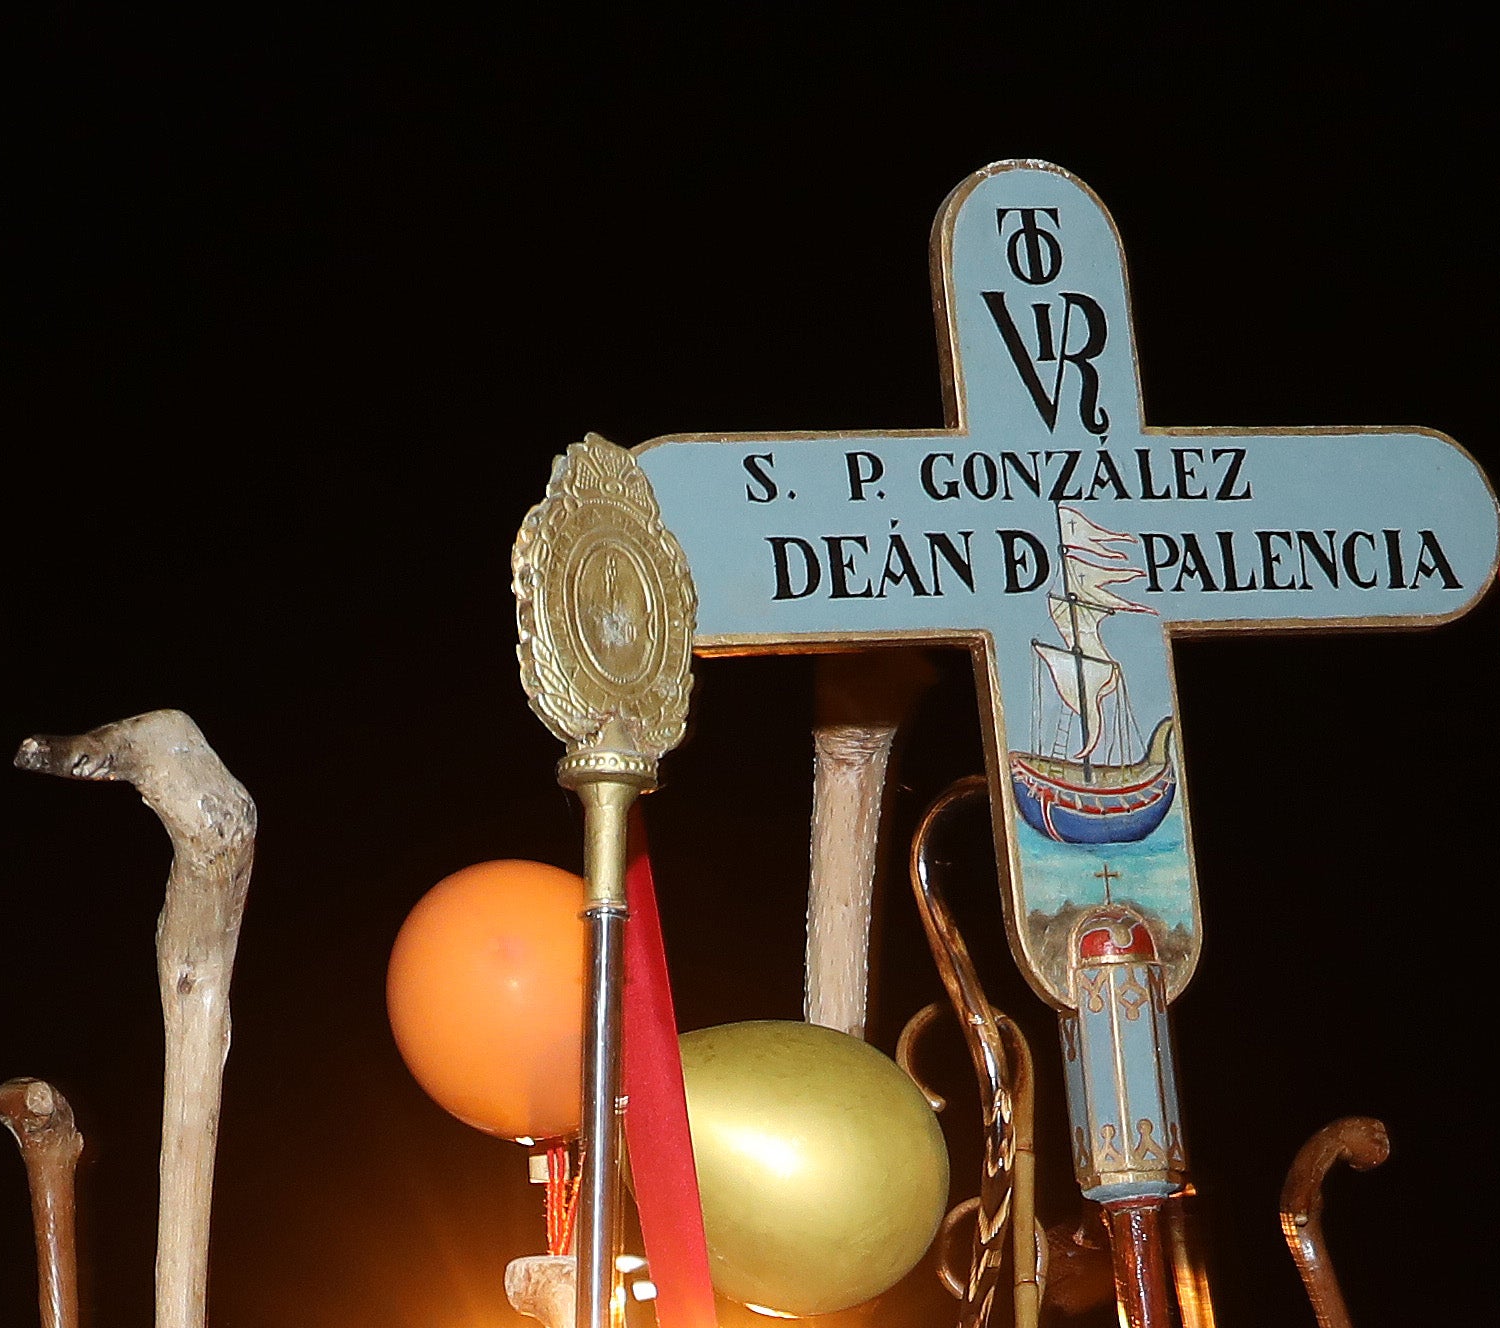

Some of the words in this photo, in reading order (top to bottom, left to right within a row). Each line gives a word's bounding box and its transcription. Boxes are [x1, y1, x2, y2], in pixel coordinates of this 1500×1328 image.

[743, 452, 796, 503] S.
[845, 451, 885, 501] P.
[920, 434, 1252, 501] GONZÁLEZ
[766, 519, 975, 601] DEÁN
[1138, 529, 1464, 593] PALENCIA
